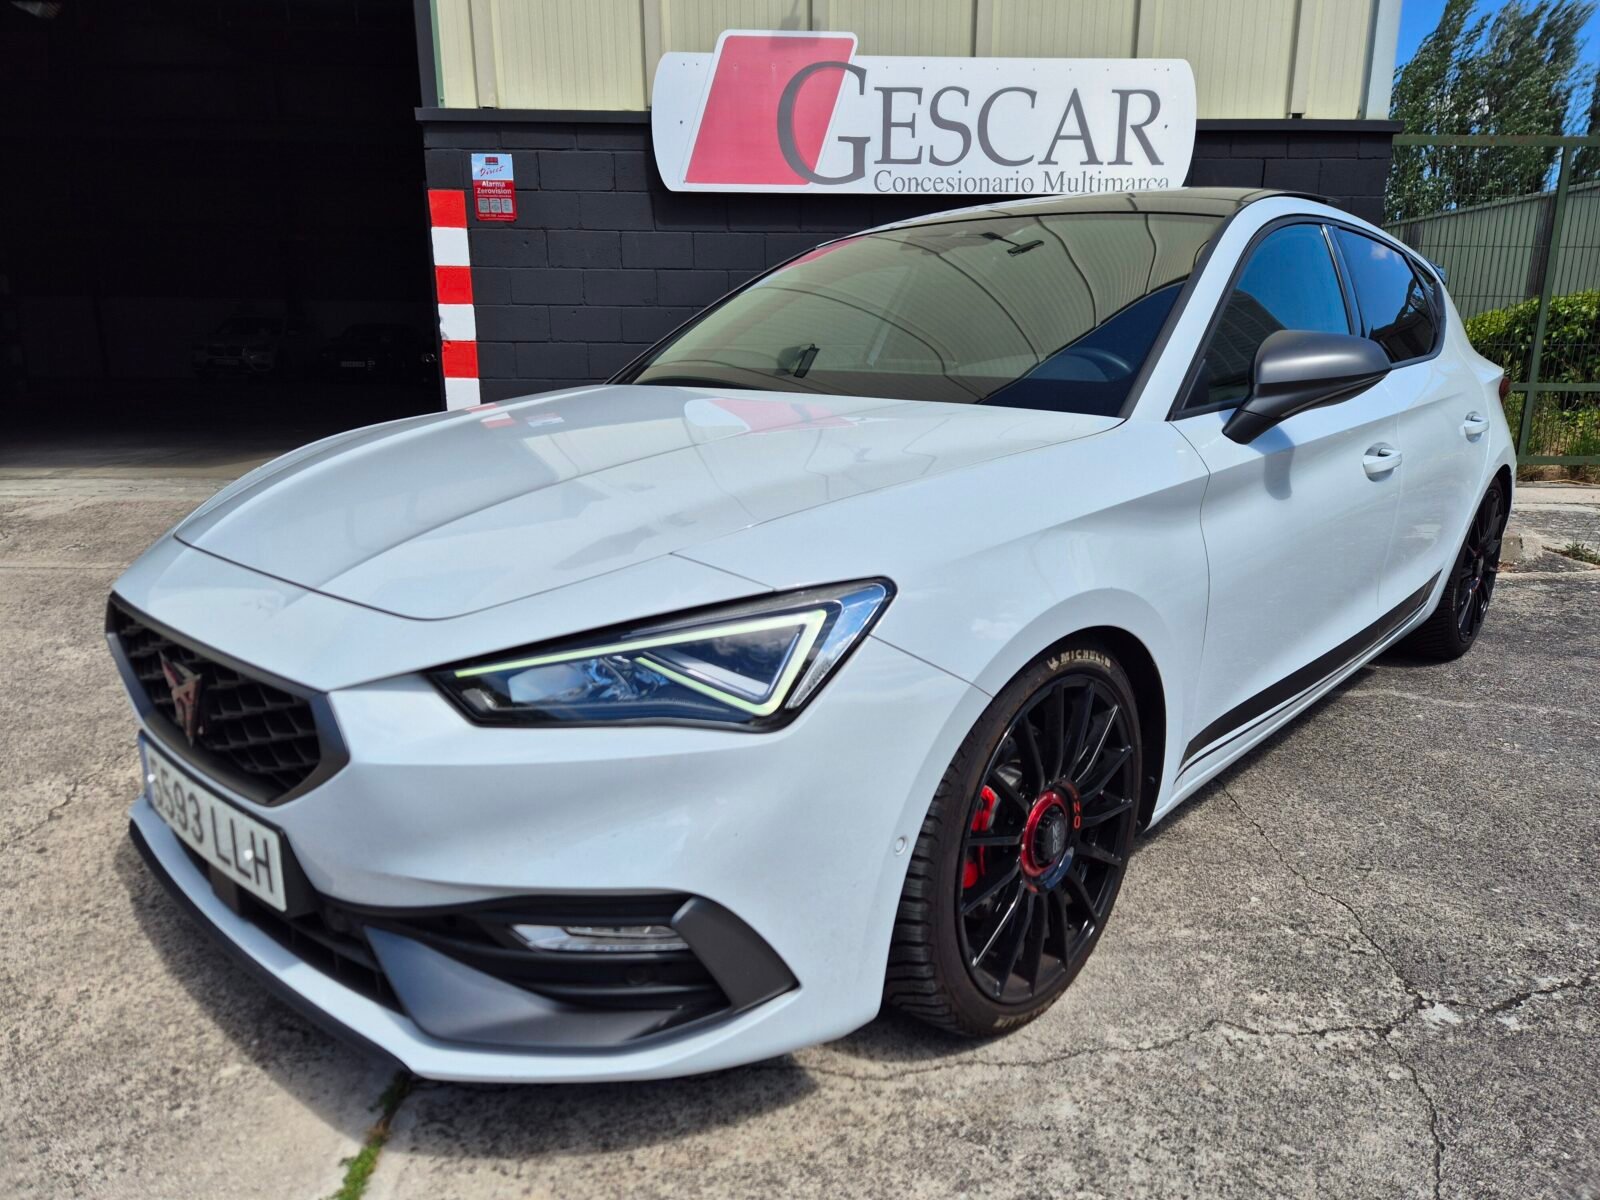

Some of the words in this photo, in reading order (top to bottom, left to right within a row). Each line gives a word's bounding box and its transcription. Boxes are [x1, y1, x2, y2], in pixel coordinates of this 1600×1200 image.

[776, 60, 1164, 186] GESCAR
[481, 180, 506, 188] Alarma
[873, 169, 1035, 193] Concesionario
[1043, 170, 1169, 193] Multimarca
[1060, 649, 1111, 668] MICHELIN
[211, 805, 274, 895] LLH
